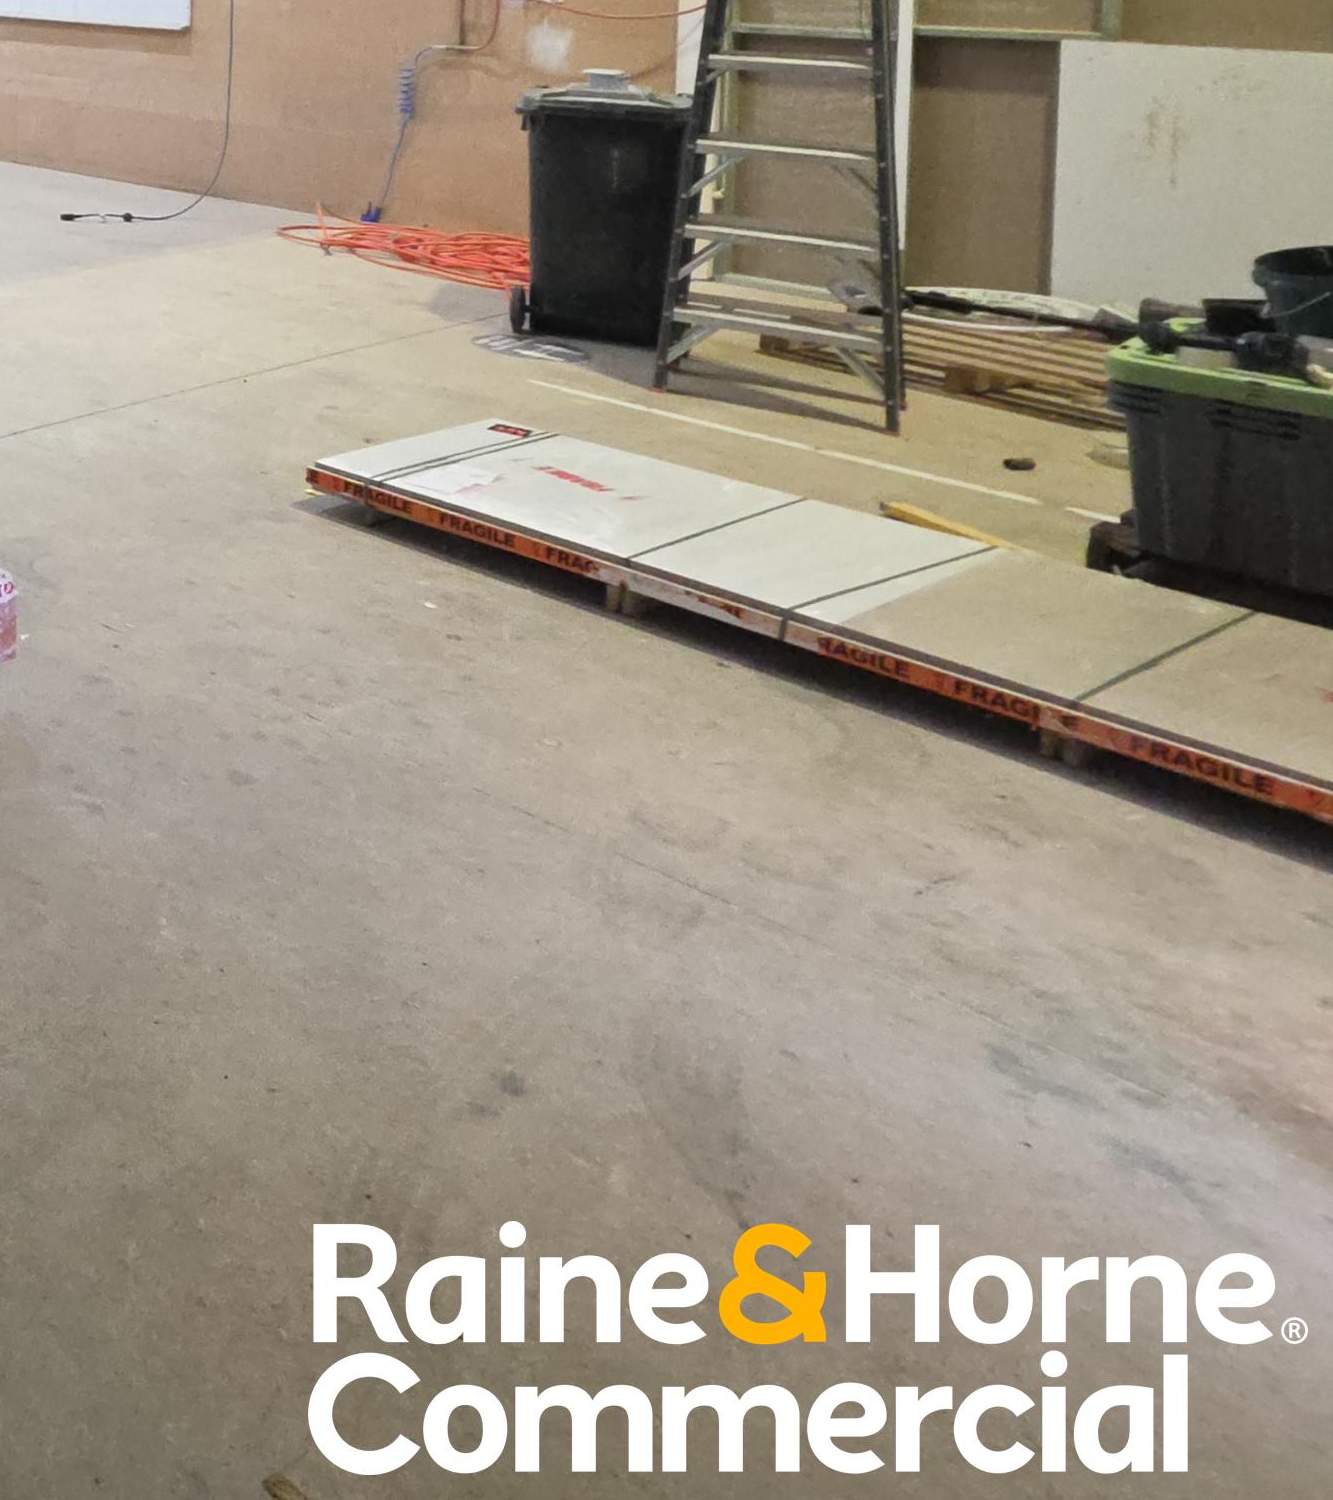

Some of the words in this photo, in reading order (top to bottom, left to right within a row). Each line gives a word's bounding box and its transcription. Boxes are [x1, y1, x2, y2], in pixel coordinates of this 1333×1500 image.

[343, 477, 413, 515] FRAGILE
[439, 511, 516, 550] FRAGILE
[1129, 734, 1274, 796] FRAGILE
